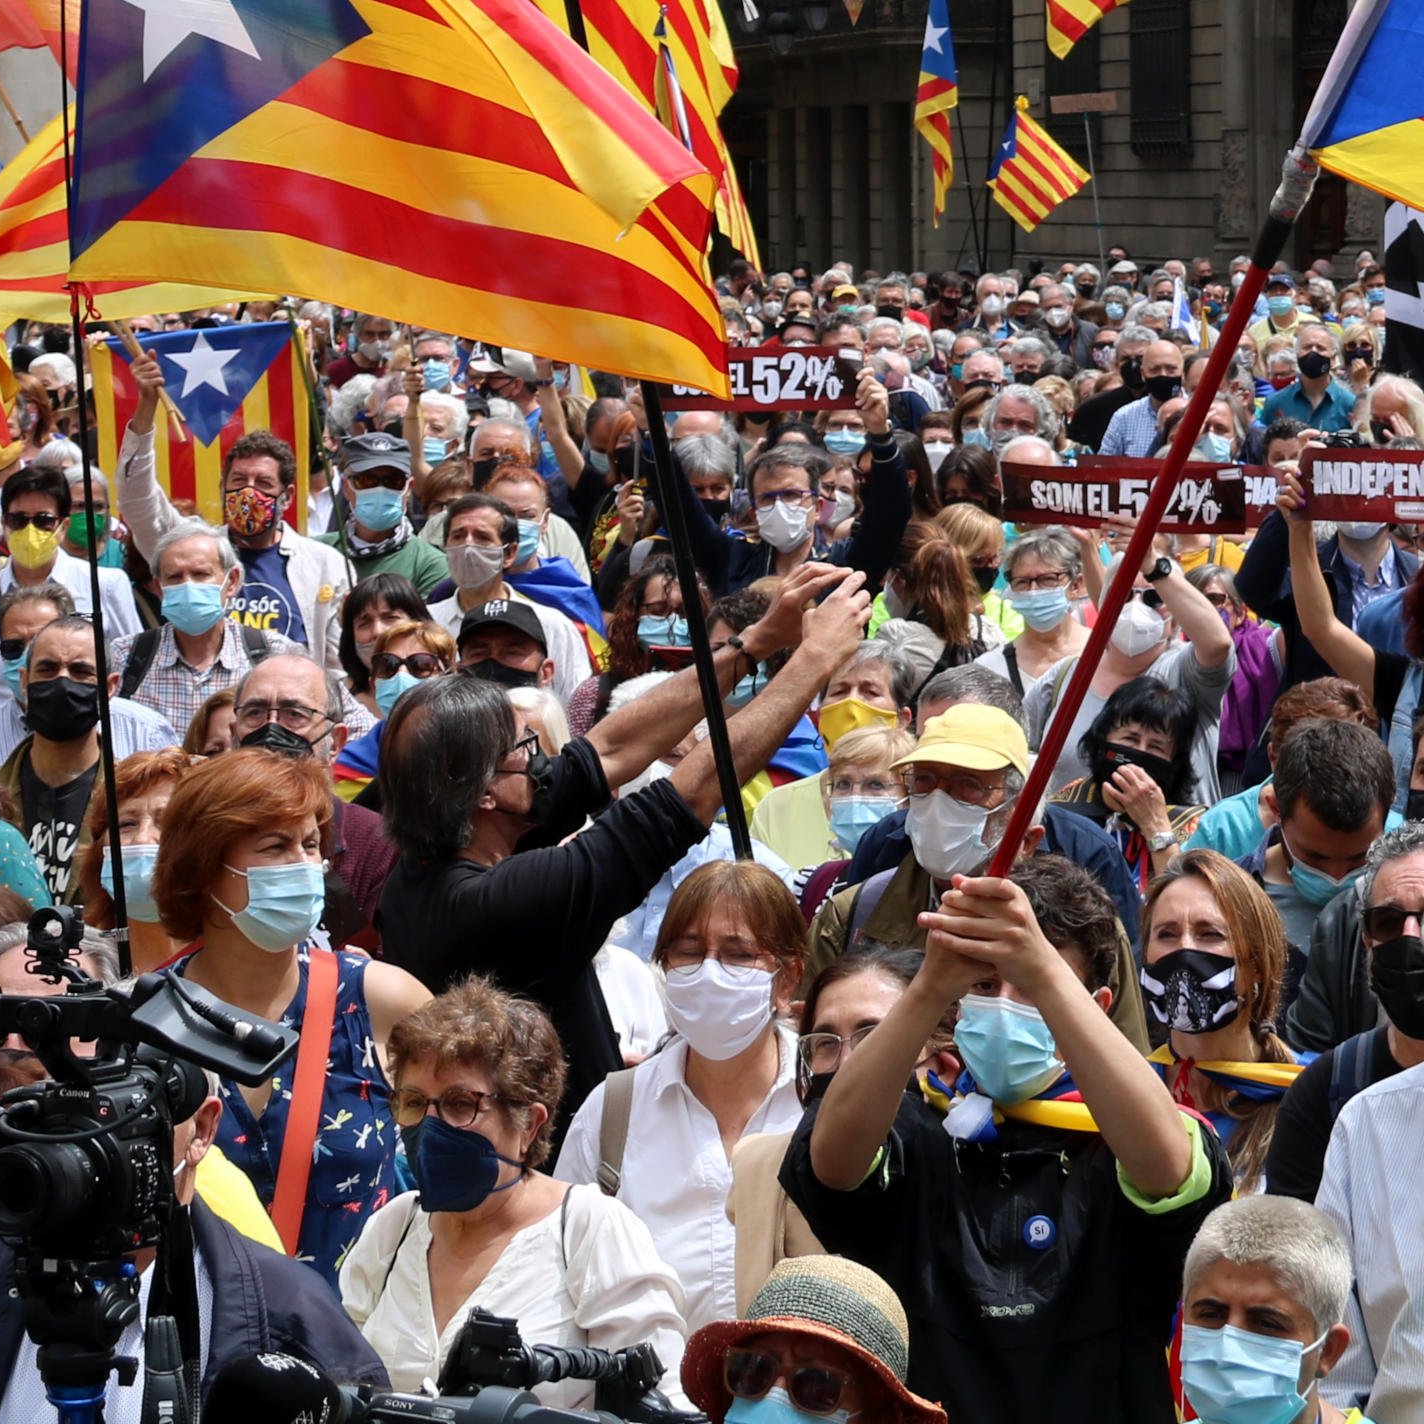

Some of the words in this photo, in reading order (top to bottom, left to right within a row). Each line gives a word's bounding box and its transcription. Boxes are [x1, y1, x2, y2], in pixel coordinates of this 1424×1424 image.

[752, 352, 844, 404] 52%
[1030, 479, 1083, 517] SOM
[1086, 483, 1115, 519] EL
[59, 1088, 90, 1098] Canon
[384, 1398, 416, 1411] SONY
